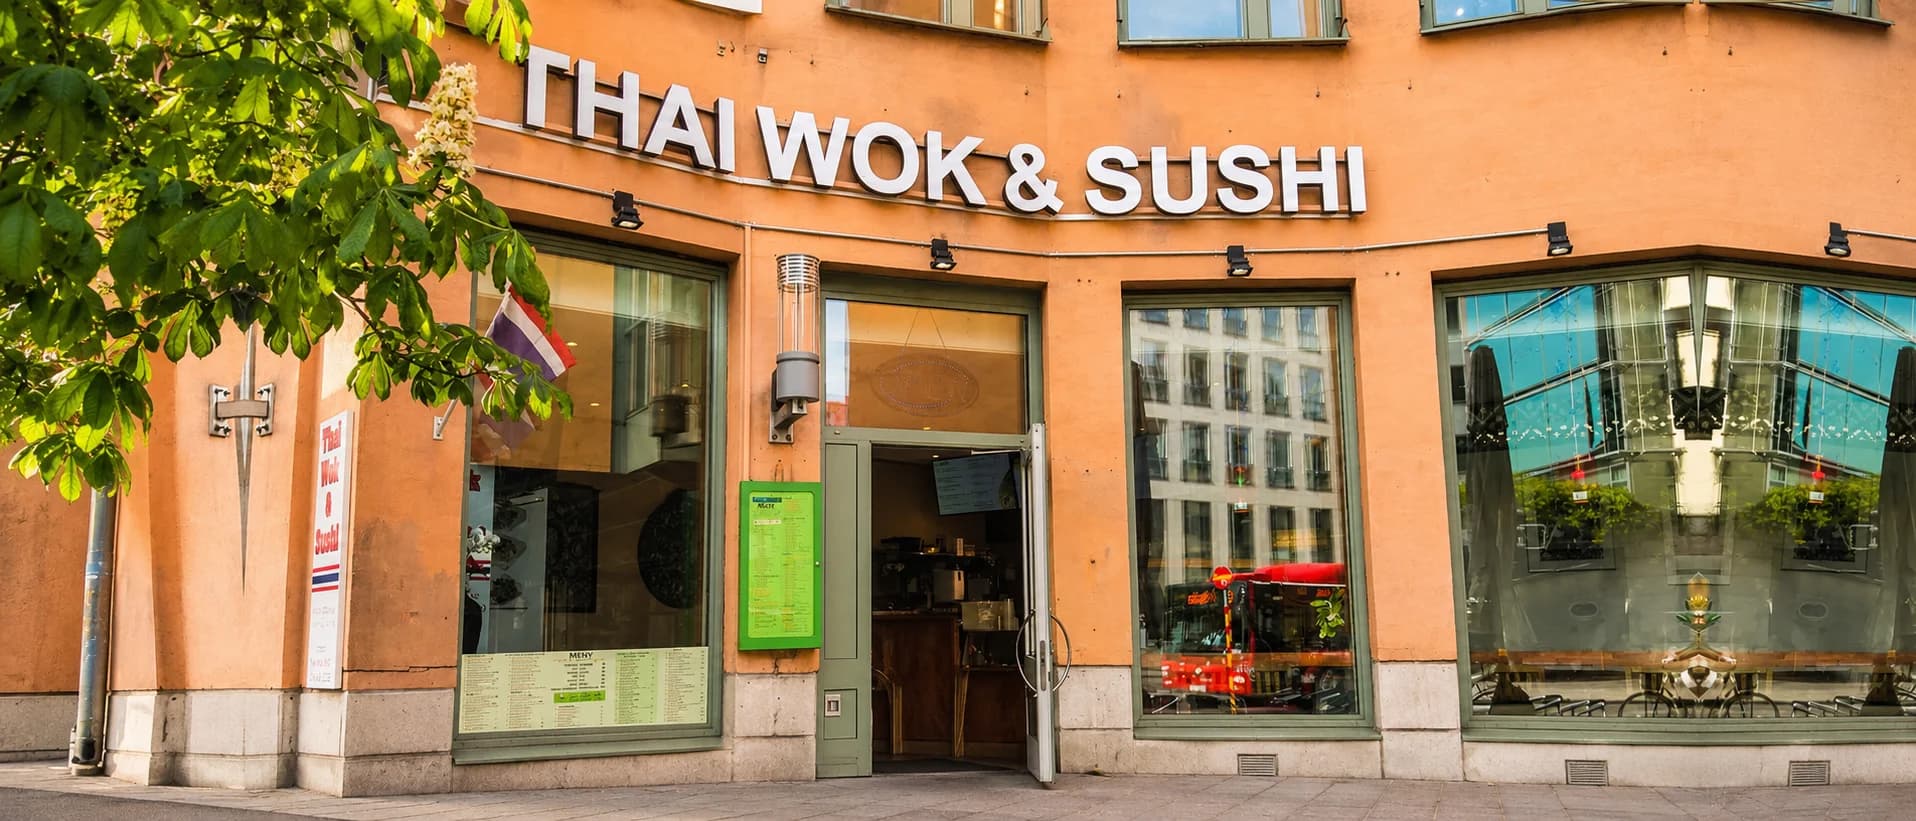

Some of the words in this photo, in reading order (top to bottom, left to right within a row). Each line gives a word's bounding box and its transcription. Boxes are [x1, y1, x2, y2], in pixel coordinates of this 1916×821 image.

[516, 42, 736, 173] THAI
[755, 105, 988, 208] WOK
[1003, 143, 1065, 215] &
[1085, 145, 1367, 215] SUSHI
[322, 420, 342, 454] Thai
[320, 456, 340, 488] Wok
[315, 522, 340, 555] Sushi
